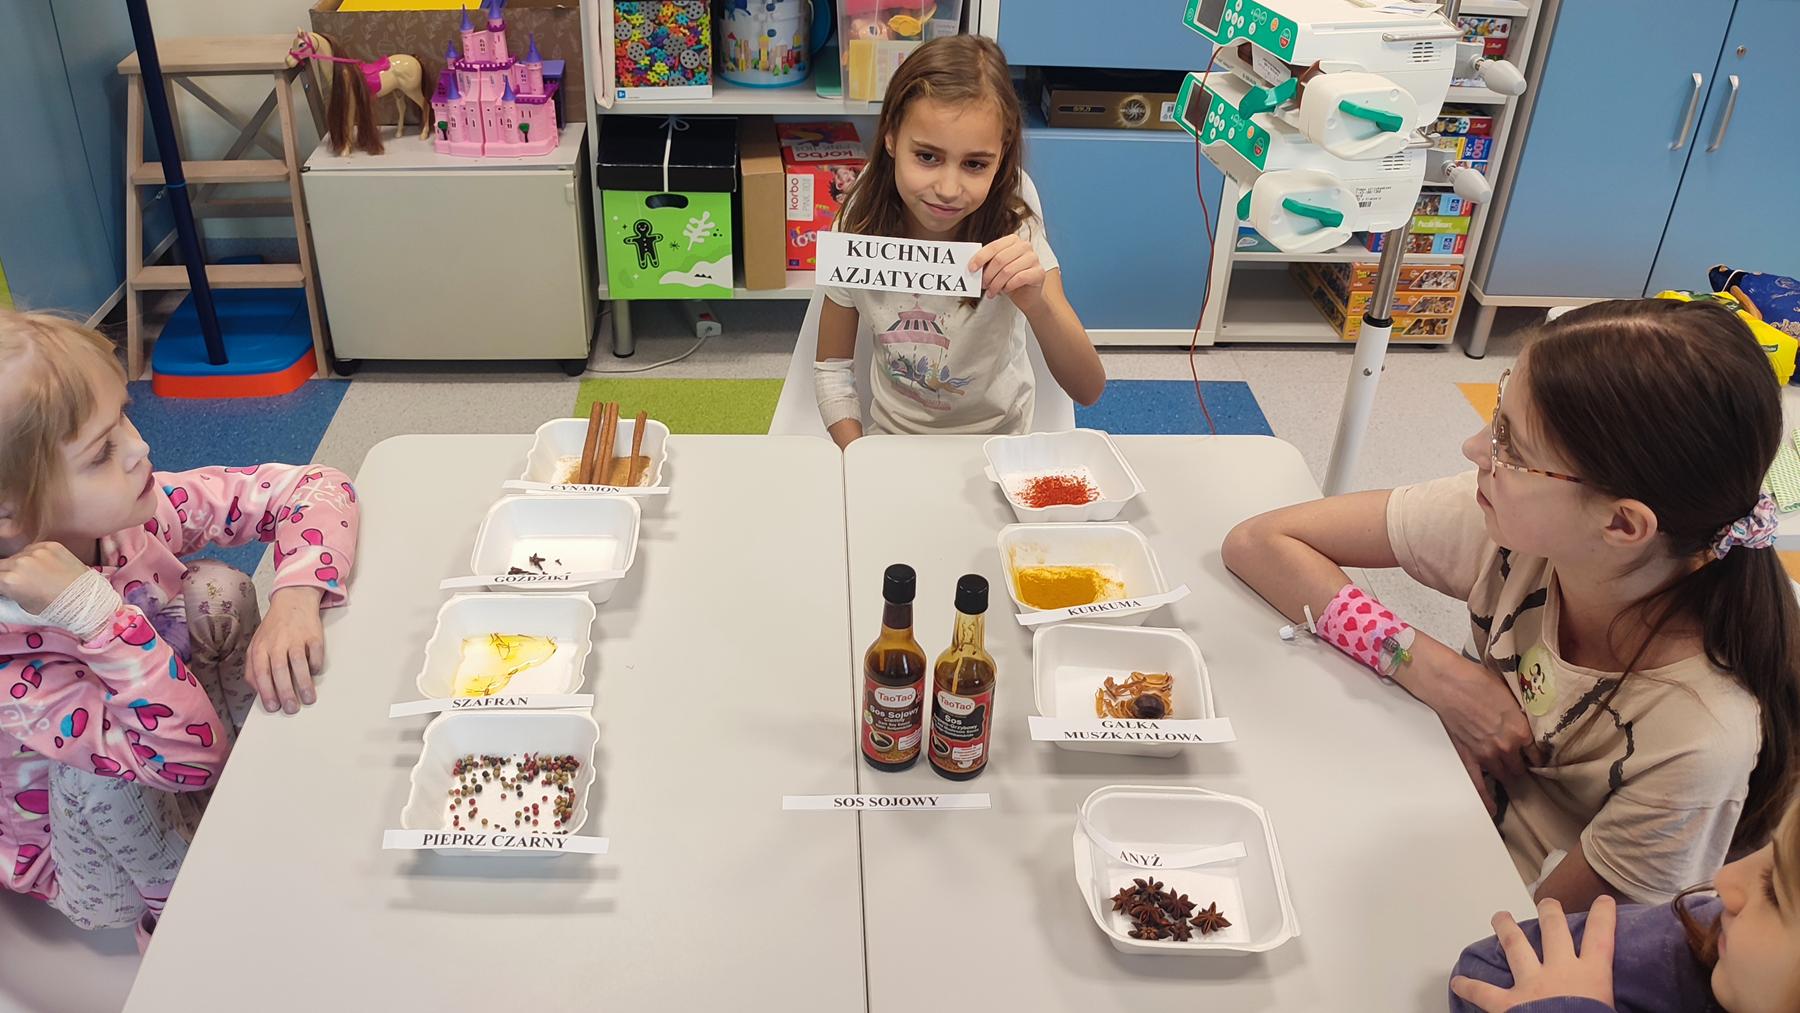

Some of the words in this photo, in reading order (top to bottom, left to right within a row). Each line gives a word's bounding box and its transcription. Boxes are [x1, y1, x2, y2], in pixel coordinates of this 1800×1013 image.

[797, 150, 853, 159] korbo
[789, 178, 799, 210] korbo
[846, 239, 956, 265] KUCHNIA
[828, 266, 968, 292] AZJATYCKA
[550, 484, 621, 493] CYNAMON
[1067, 598, 1142, 616] KURKUMA
[451, 697, 529, 708] SZAFRAN
[878, 691, 913, 702] TaoTao
[940, 695, 972, 711] TaoTao
[869, 704, 886, 717] Sos
[944, 714, 962, 725] Sos
[1101, 720, 1160, 730] GAŁKA
[1064, 731, 1203, 742] MUSZKATAŁOWA
[834, 797, 865, 807] SOS
[869, 796, 939, 807] SOJOWY
[422, 833, 488, 847] PIEPRZ
[491, 834, 569, 849] CZARNY
[1120, 850, 1163, 867] ANYŻ
